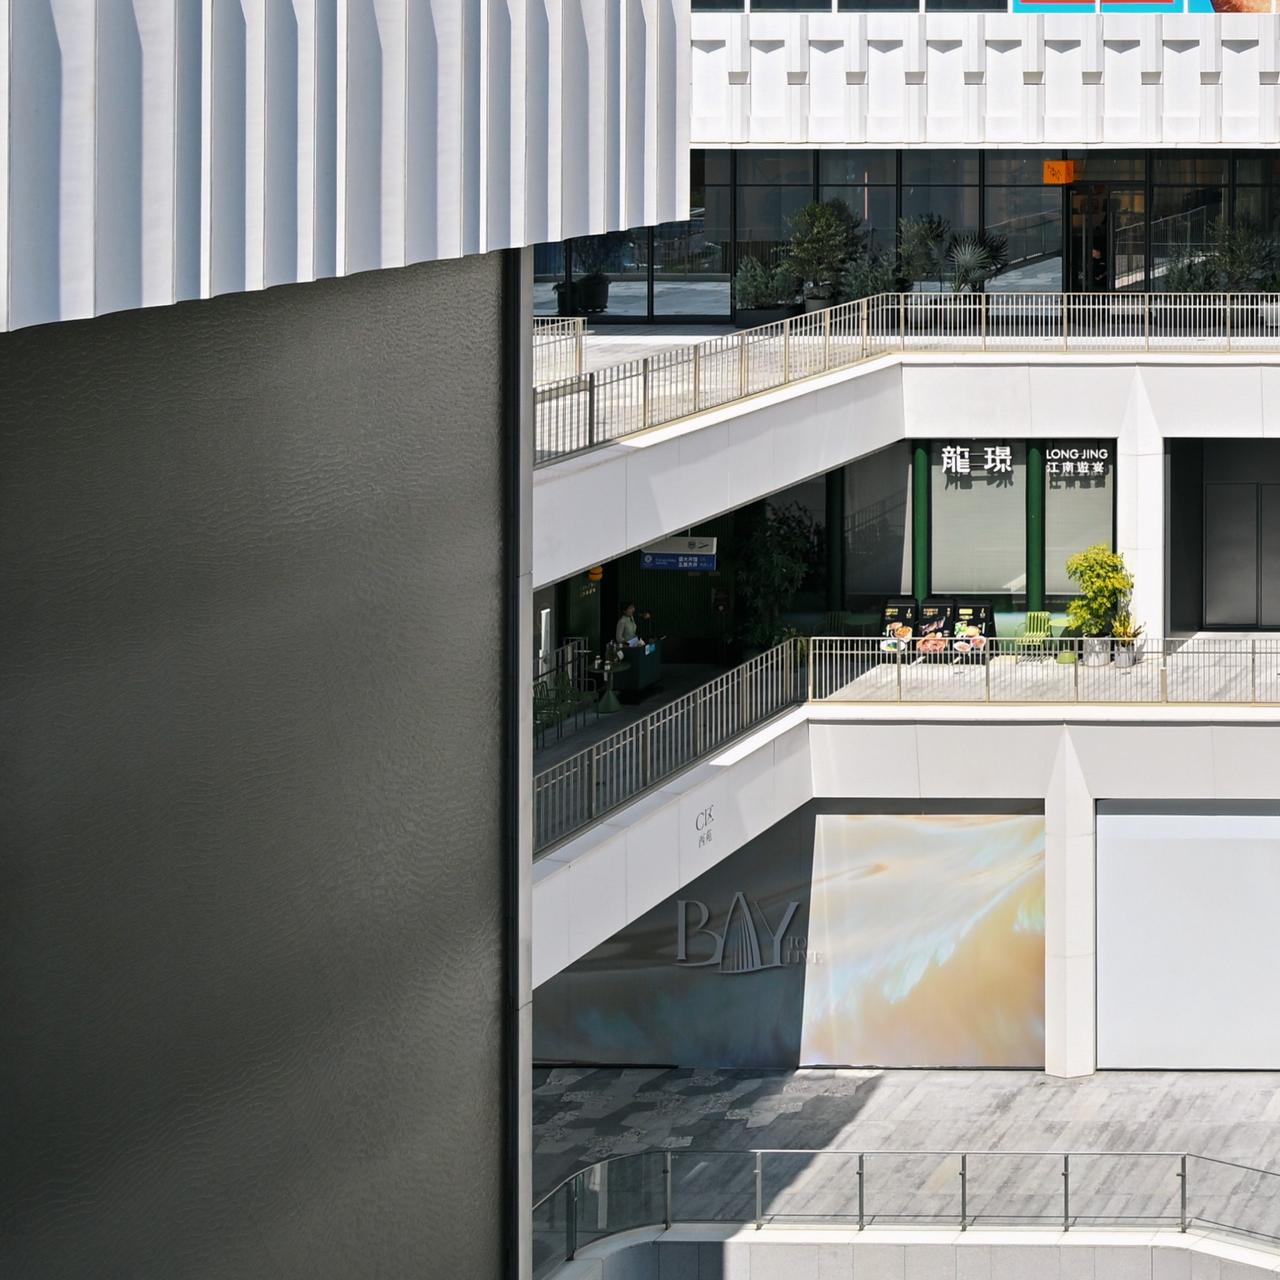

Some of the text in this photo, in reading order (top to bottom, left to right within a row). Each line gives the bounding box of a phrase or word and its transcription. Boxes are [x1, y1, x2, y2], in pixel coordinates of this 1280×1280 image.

[1046, 449, 1108, 459] LONG JING
[672, 891, 800, 974] BAY
